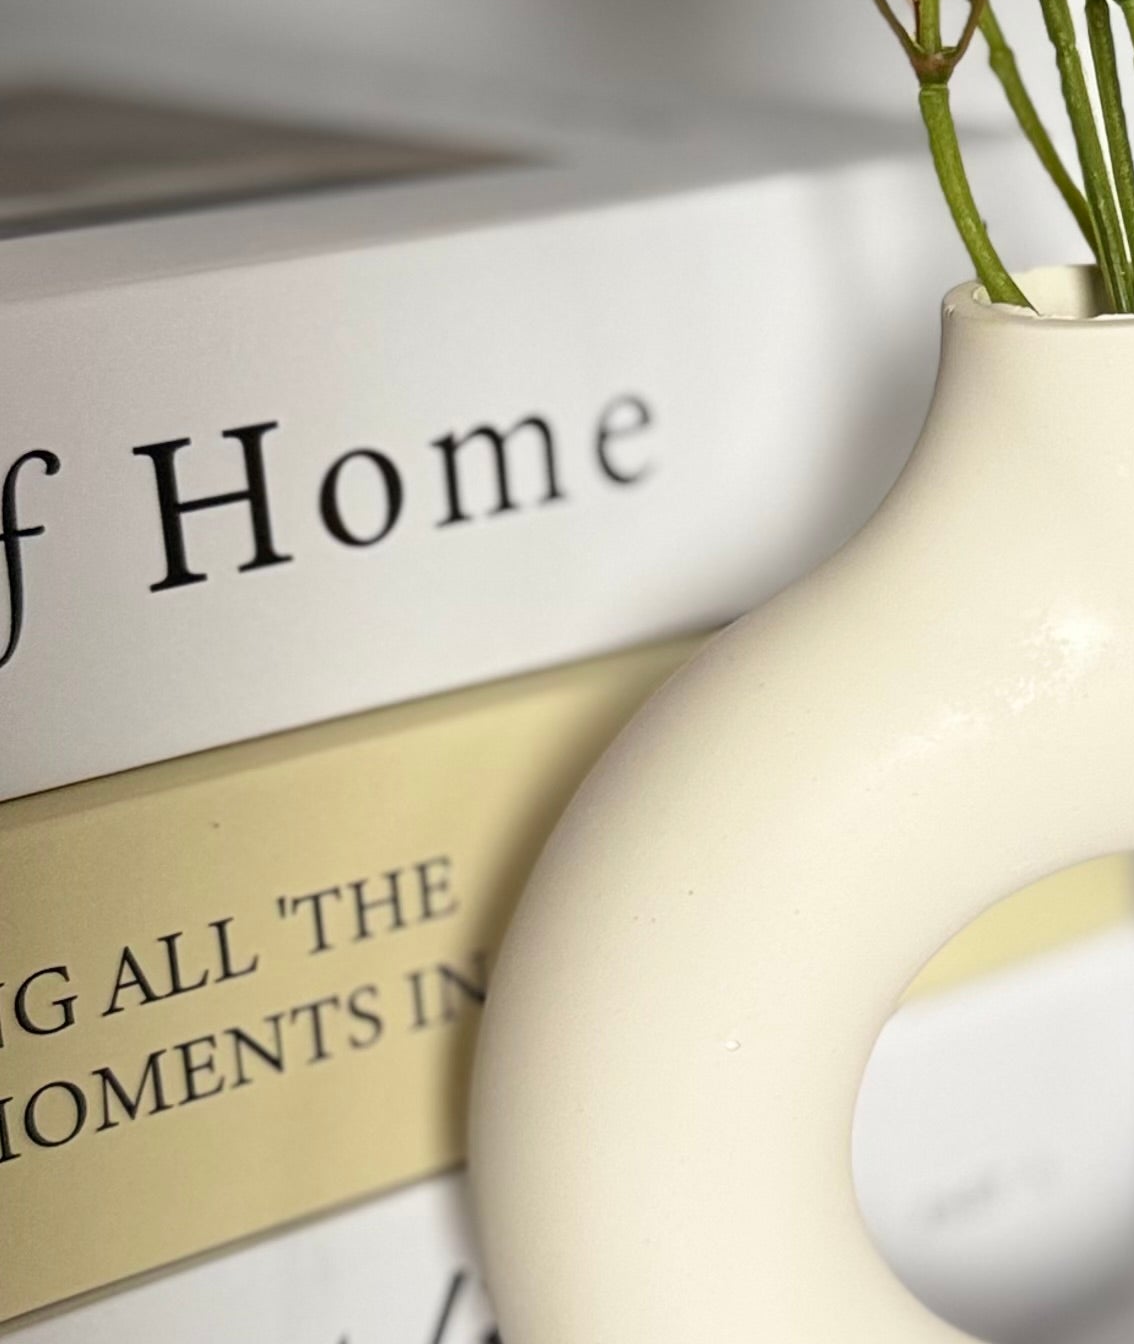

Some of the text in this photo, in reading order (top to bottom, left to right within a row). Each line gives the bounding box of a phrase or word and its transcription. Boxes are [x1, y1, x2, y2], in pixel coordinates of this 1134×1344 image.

[132, 393, 656, 594] Home
[0, 965, 78, 1049] G
[101, 916, 260, 1017] ALL
